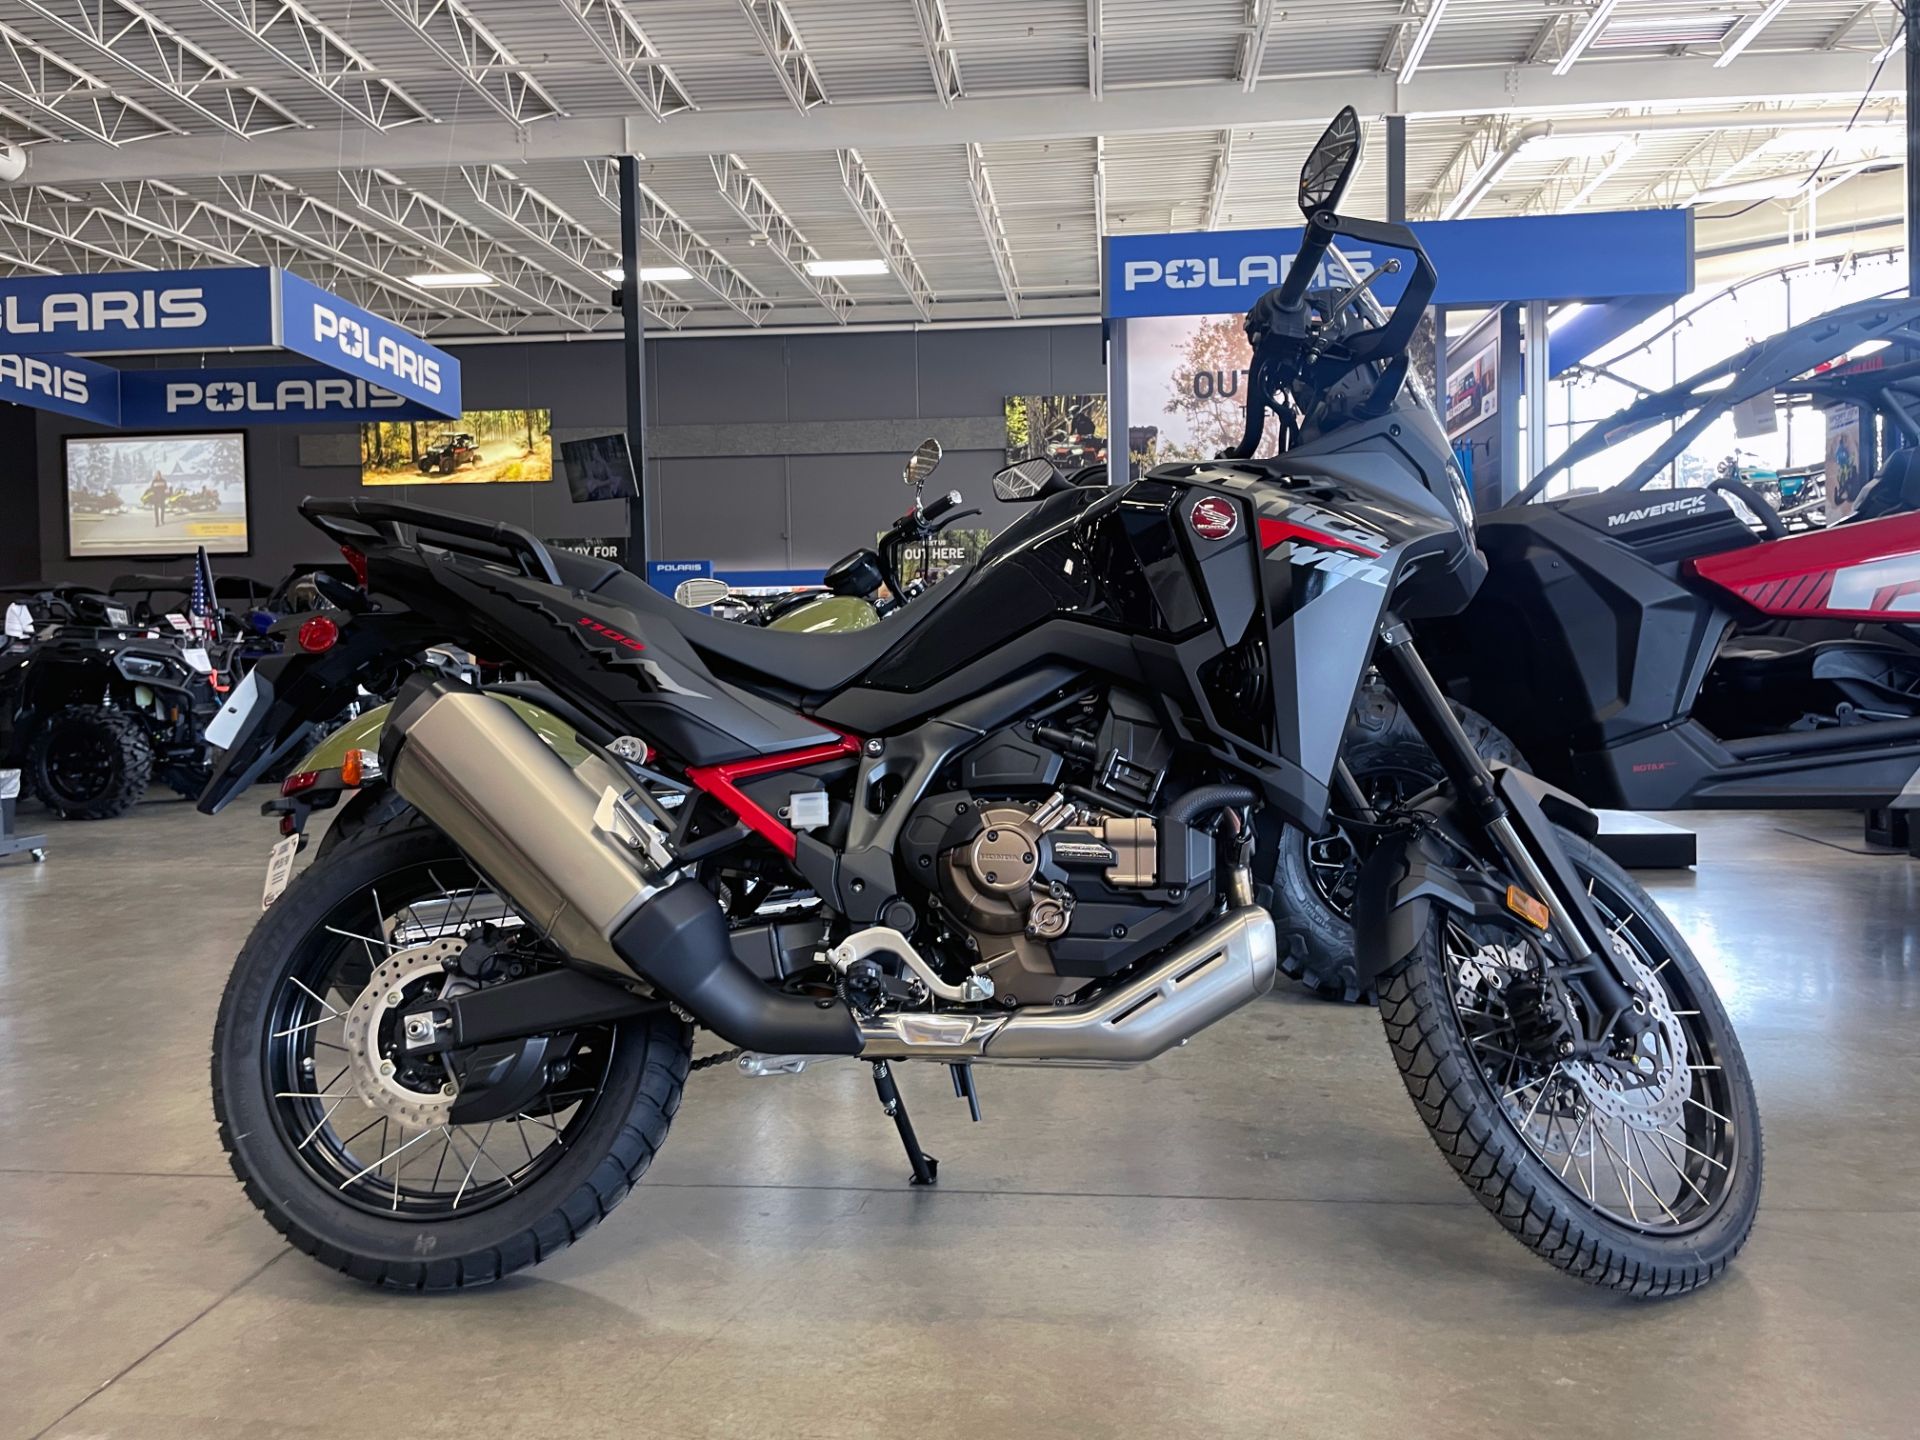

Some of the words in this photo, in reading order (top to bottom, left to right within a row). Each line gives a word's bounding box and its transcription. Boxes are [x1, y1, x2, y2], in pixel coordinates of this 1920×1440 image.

[0, 288, 207, 334] LARIS
[313, 303, 442, 395] POLARIS
[166, 379, 406, 413] POLARIS
[1608, 494, 1706, 527] MAVERICK
[1197, 523, 1230, 531] HONDA
[594, 546, 618, 557] FOR
[932, 547, 965, 559] HERE
[656, 564, 702, 572] POLARIS
[979, 852, 1020, 862] HONDA
